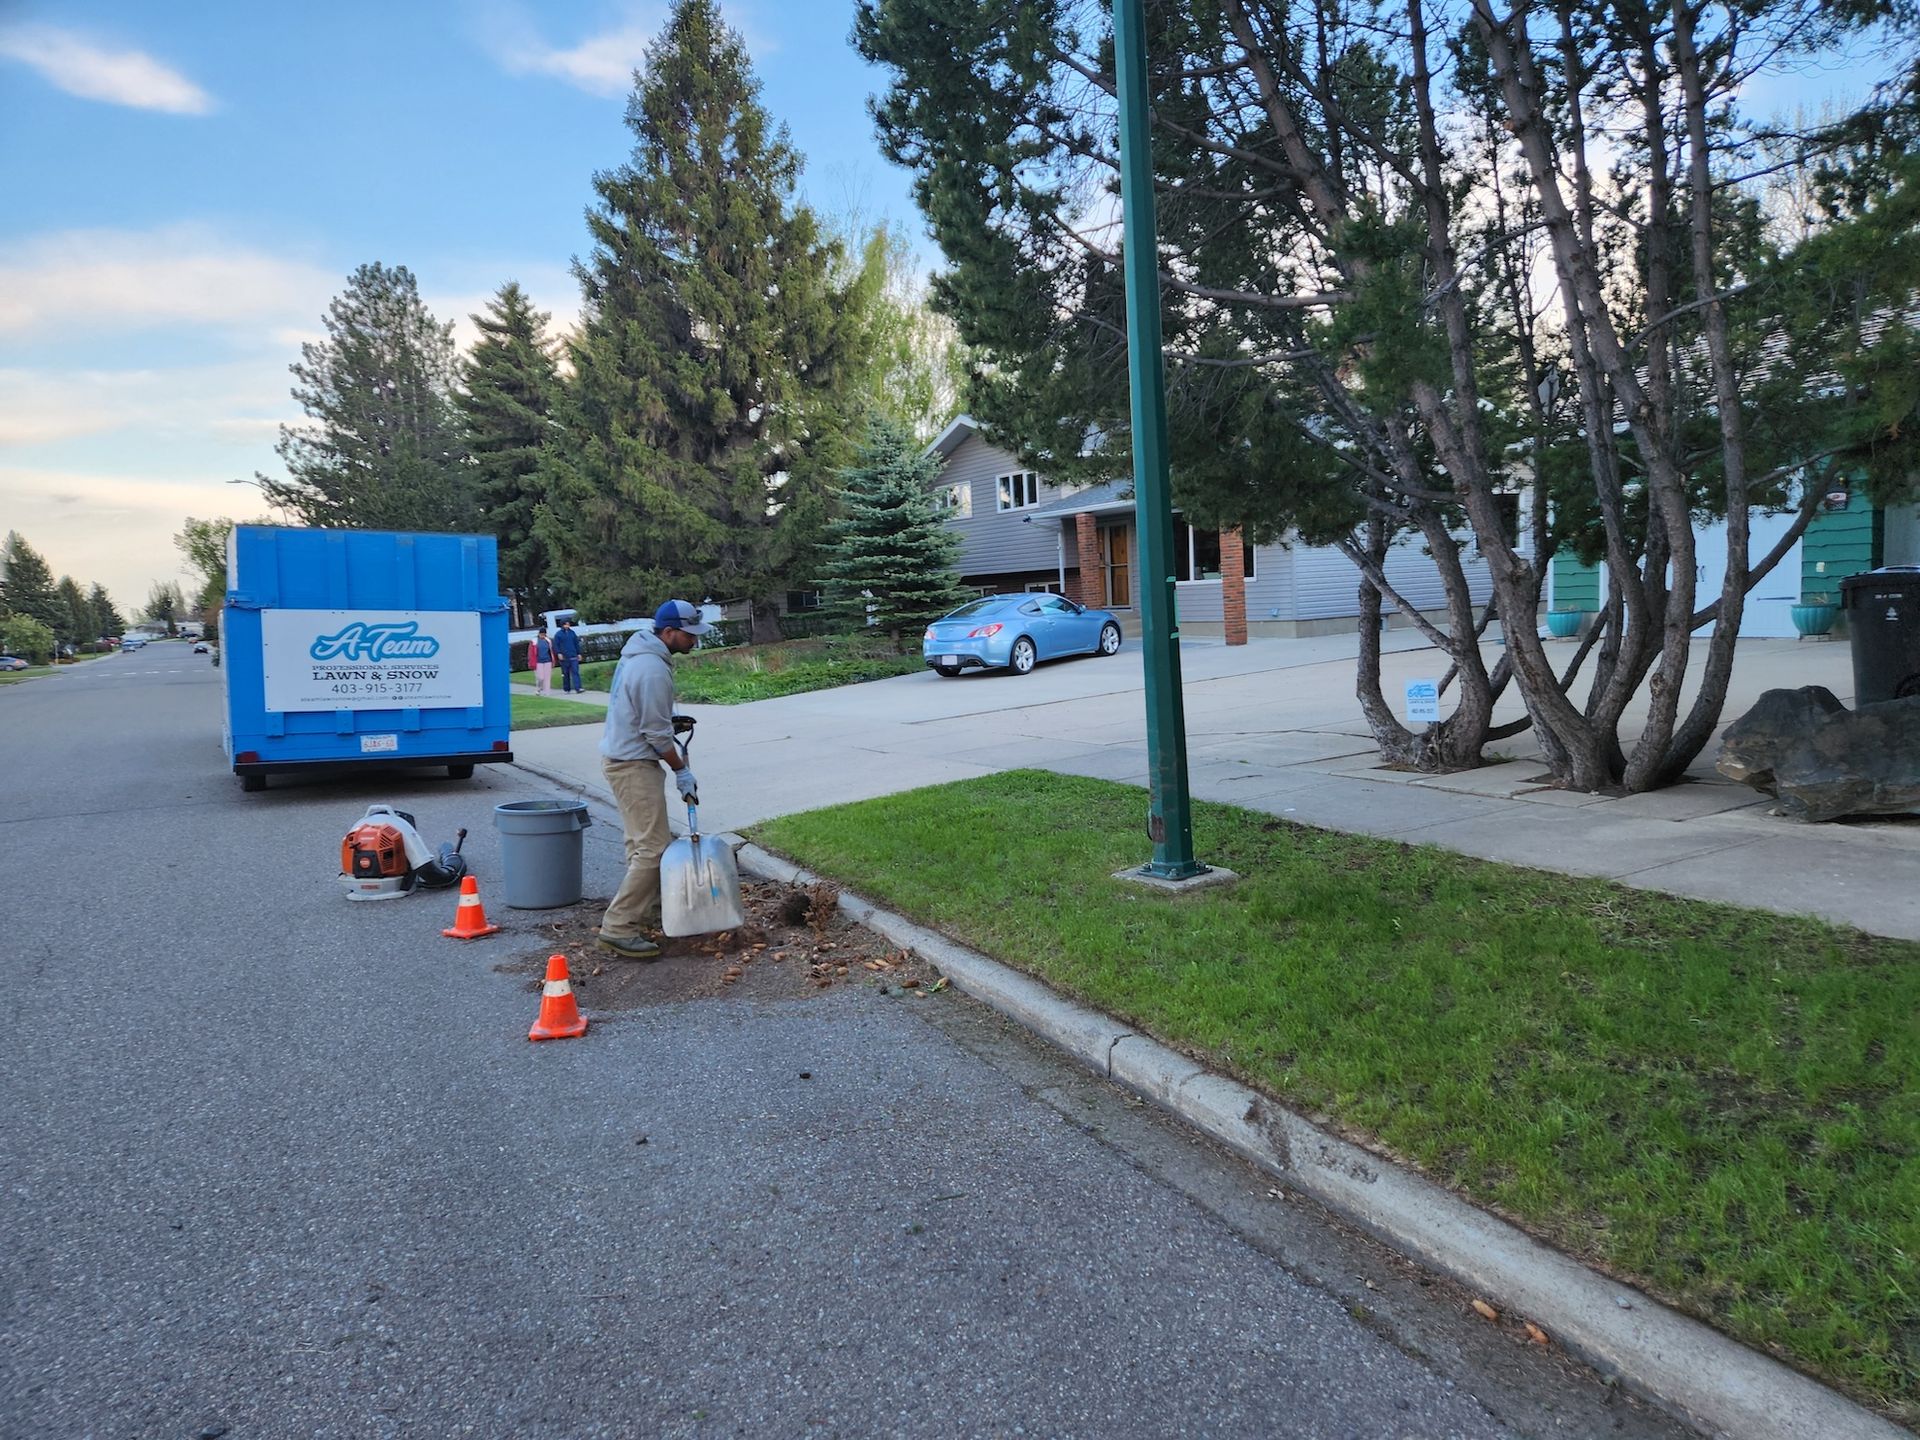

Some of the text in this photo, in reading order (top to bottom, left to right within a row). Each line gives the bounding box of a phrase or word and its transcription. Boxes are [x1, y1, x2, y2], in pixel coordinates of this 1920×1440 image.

[311, 622, 439, 661] A-Team
[312, 670, 439, 681] LAWN & SNOW
[331, 683, 422, 694] 403-915-3177
